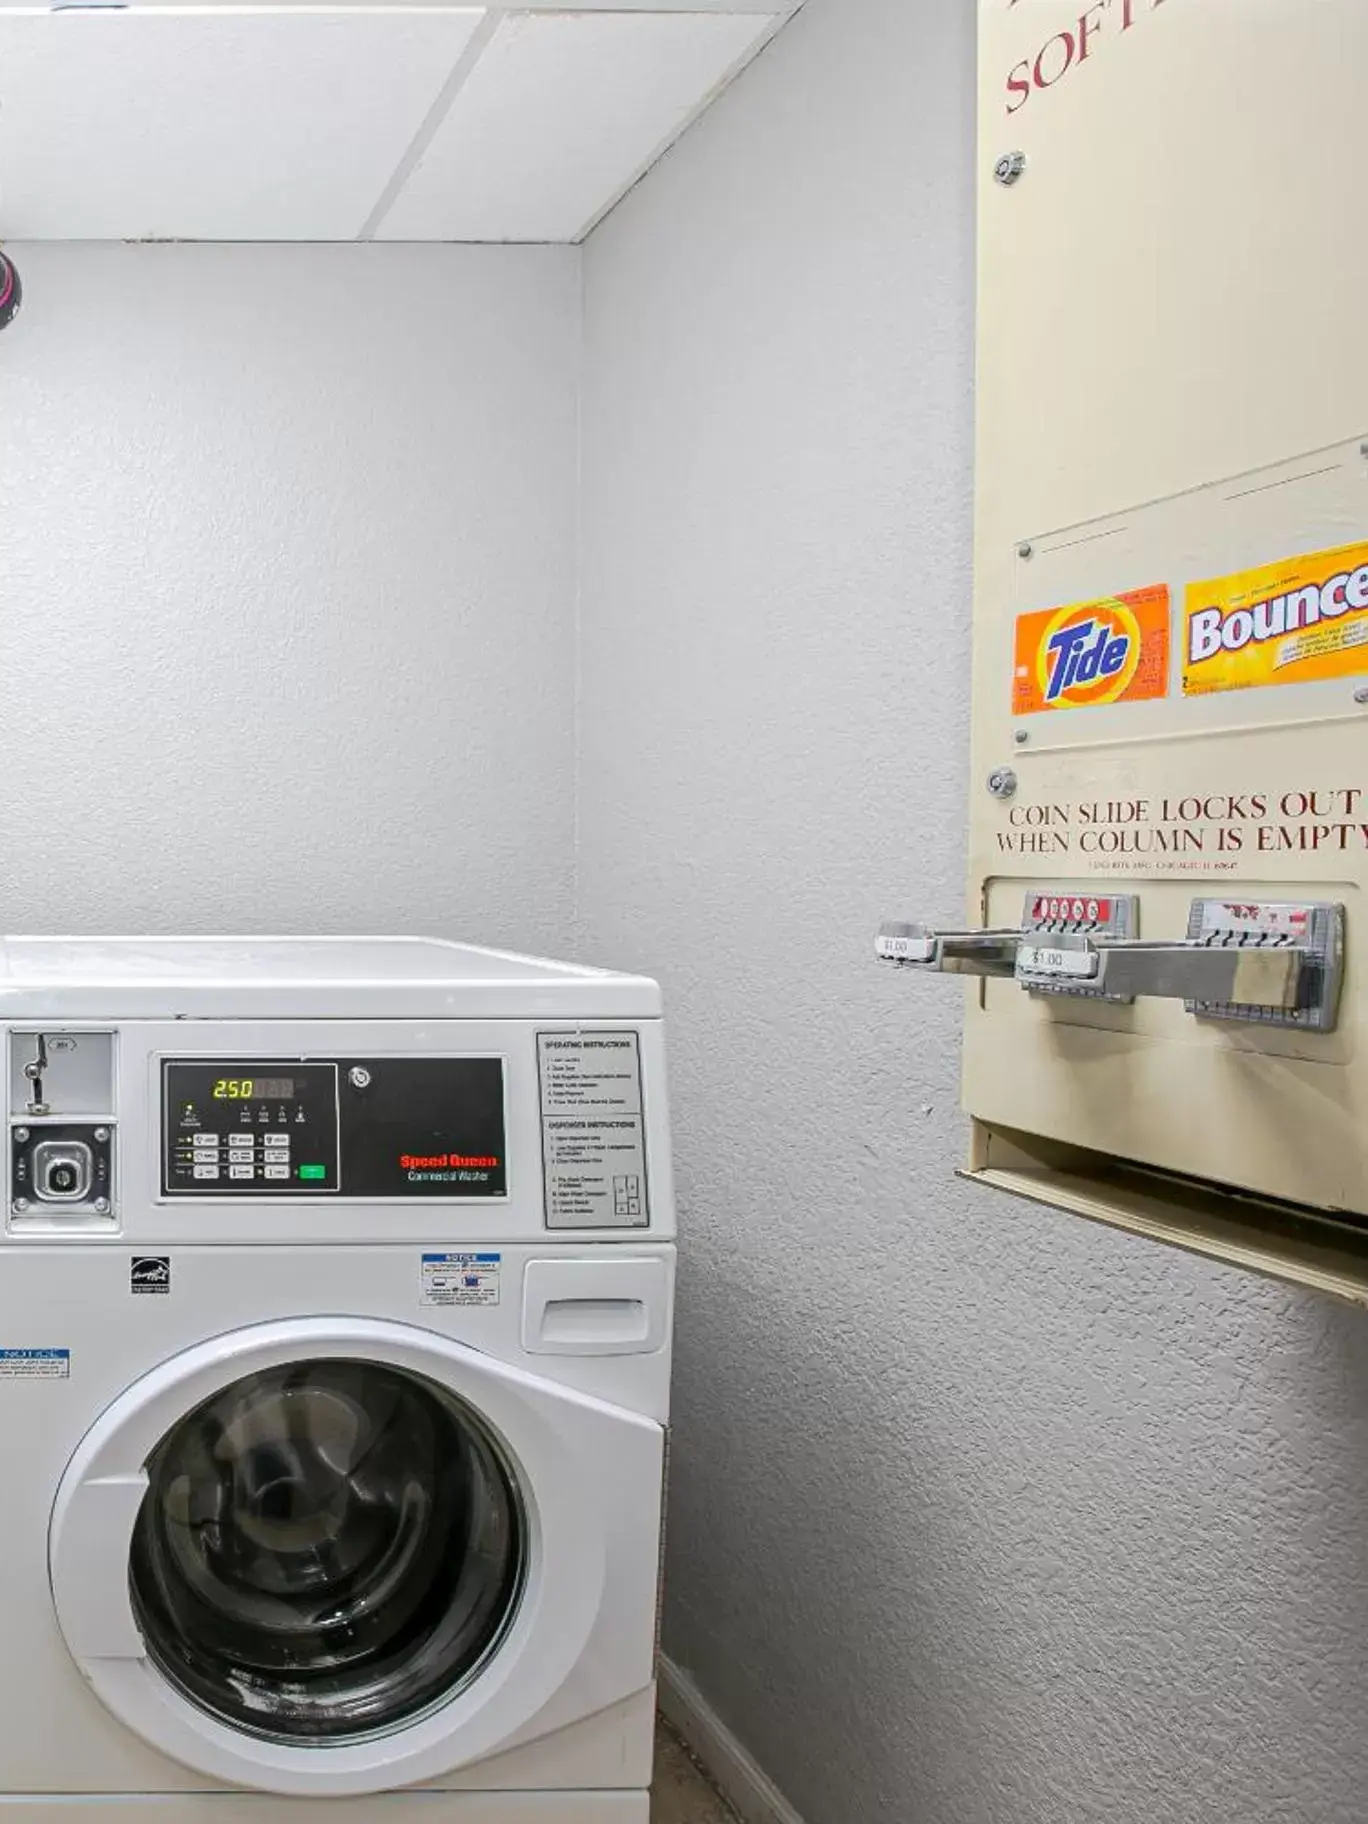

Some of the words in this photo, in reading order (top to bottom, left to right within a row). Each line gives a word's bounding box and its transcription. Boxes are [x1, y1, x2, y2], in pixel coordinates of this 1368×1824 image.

[1006, 0, 1168, 114] SOFT
[1188, 563, 1368, 666] Bounce
[1044, 618, 1130, 702] Tide
[1008, 803, 1071, 828] COIN
[1077, 799, 1149, 825] SLIDE
[1160, 793, 1267, 822] LOCKS
[1279, 788, 1362, 818] OUT
[996, 830, 1070, 853] WHEN
[1079, 828, 1204, 853] COLUMN
[1217, 827, 1243, 851] IS
[1257, 824, 1368, 851] EMPTY
[1032, 951, 1062, 966] $1.00
[400, 1154, 448, 1169] Speed
[449, 1154, 498, 1167] Queen
[458, 1171, 489, 1181] Washer
